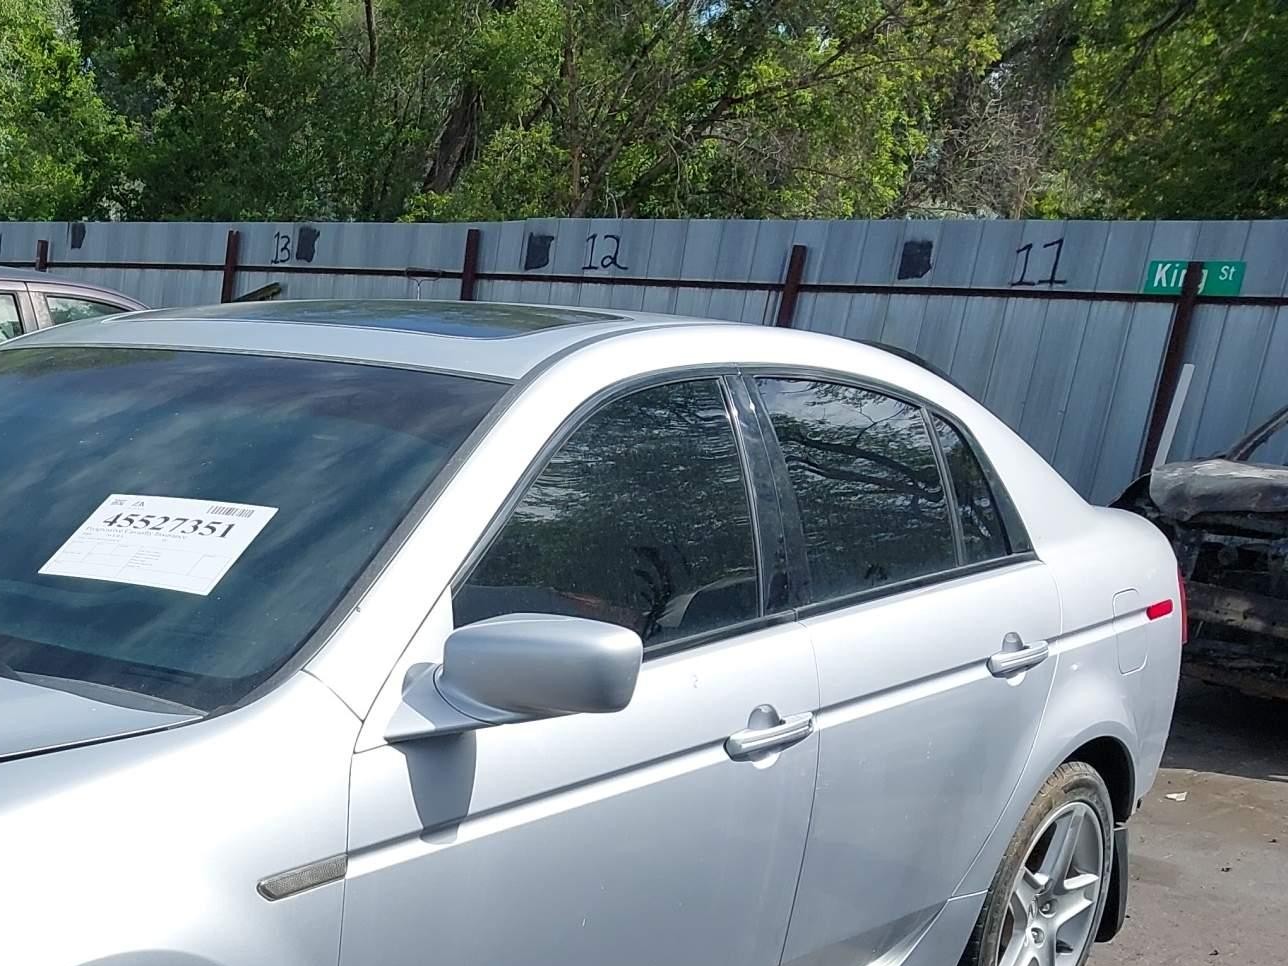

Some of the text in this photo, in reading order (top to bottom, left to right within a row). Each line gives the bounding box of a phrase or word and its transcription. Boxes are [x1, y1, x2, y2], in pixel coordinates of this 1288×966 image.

[271, 231, 291, 264] 13
[581, 233, 629, 270] 12
[1010, 238, 1067, 287] 11
[1218, 265, 1237, 281] St
[103, 512, 235, 538] 45527351
